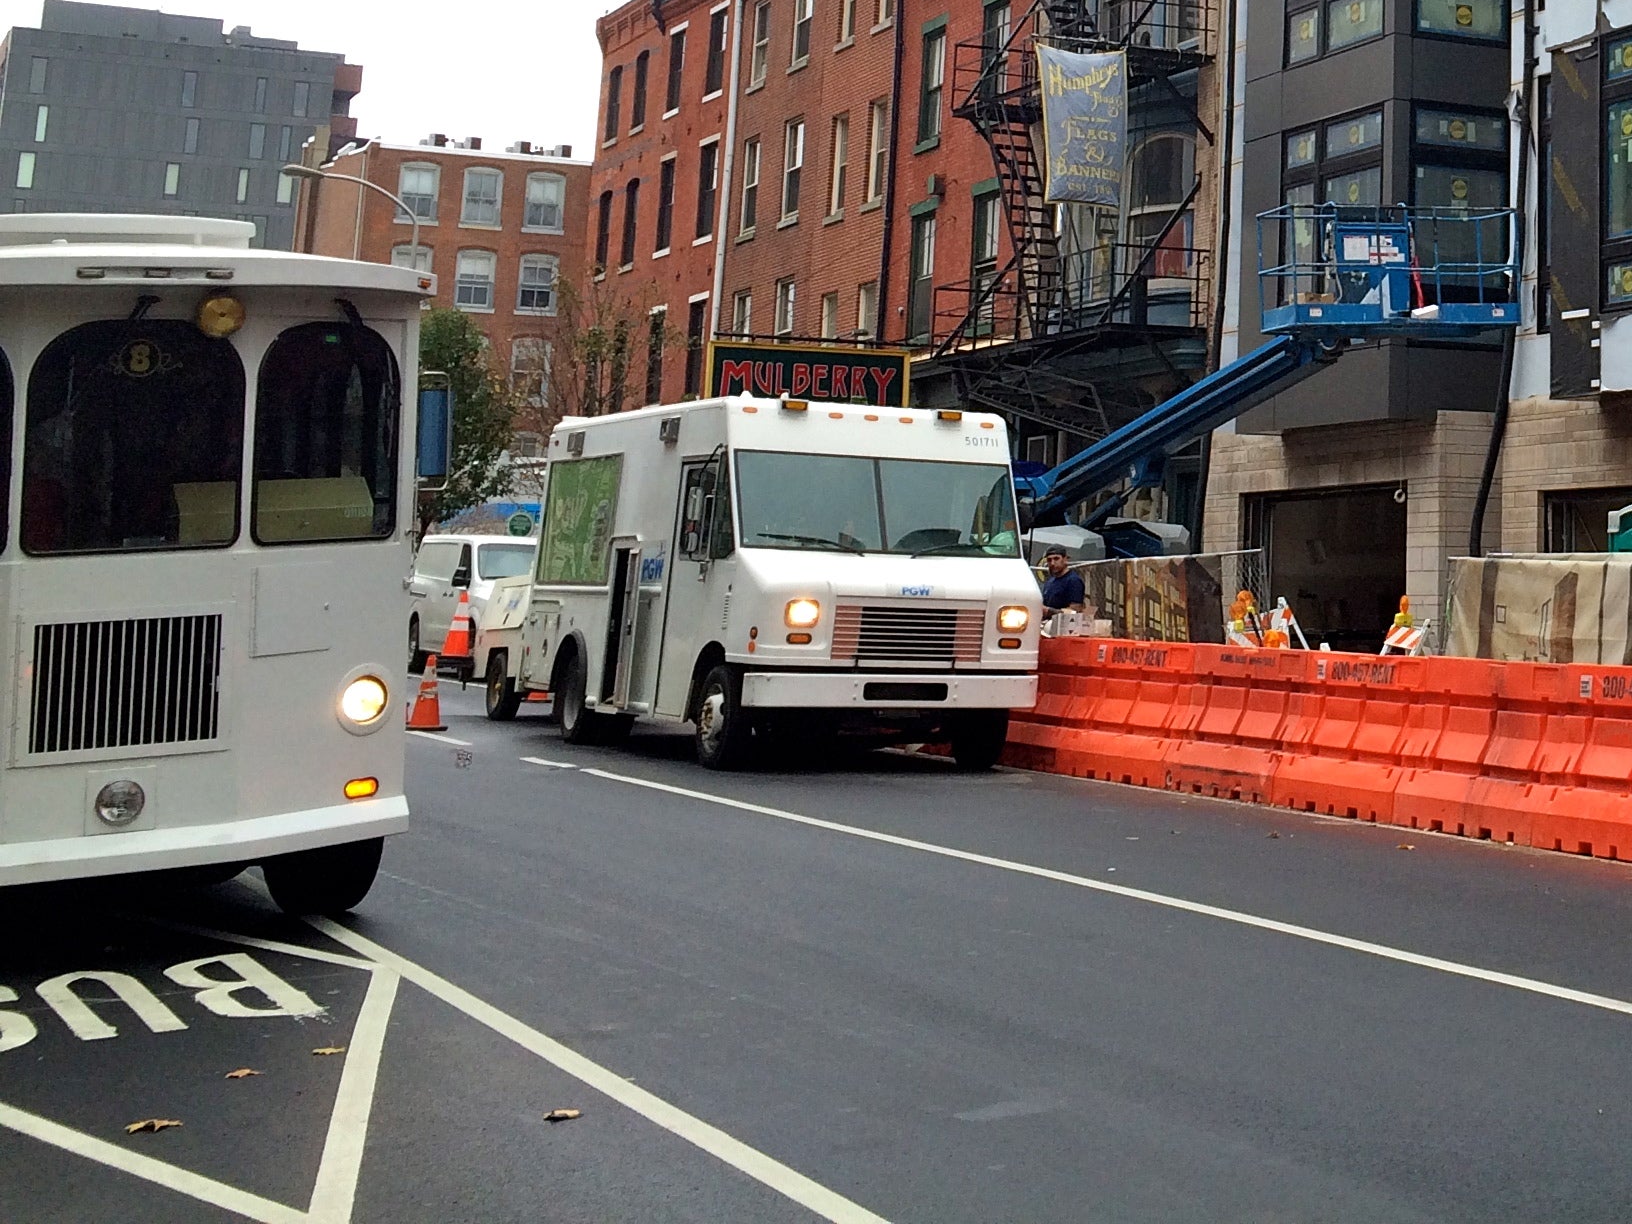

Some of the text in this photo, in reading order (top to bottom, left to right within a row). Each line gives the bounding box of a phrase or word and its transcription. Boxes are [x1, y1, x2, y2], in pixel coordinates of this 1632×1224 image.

[1049, 62, 1119, 97] Humphrys
[1060, 117, 1117, 145] FLAGS
[129, 343, 151, 372] 8
[719, 359, 897, 406] MULBERRY
[964, 435, 1000, 448] 501711
[640, 557, 665, 580] PGW
[901, 585, 931, 596] PGW
[1331, 661, 1397, 685] 800-457-RENT
